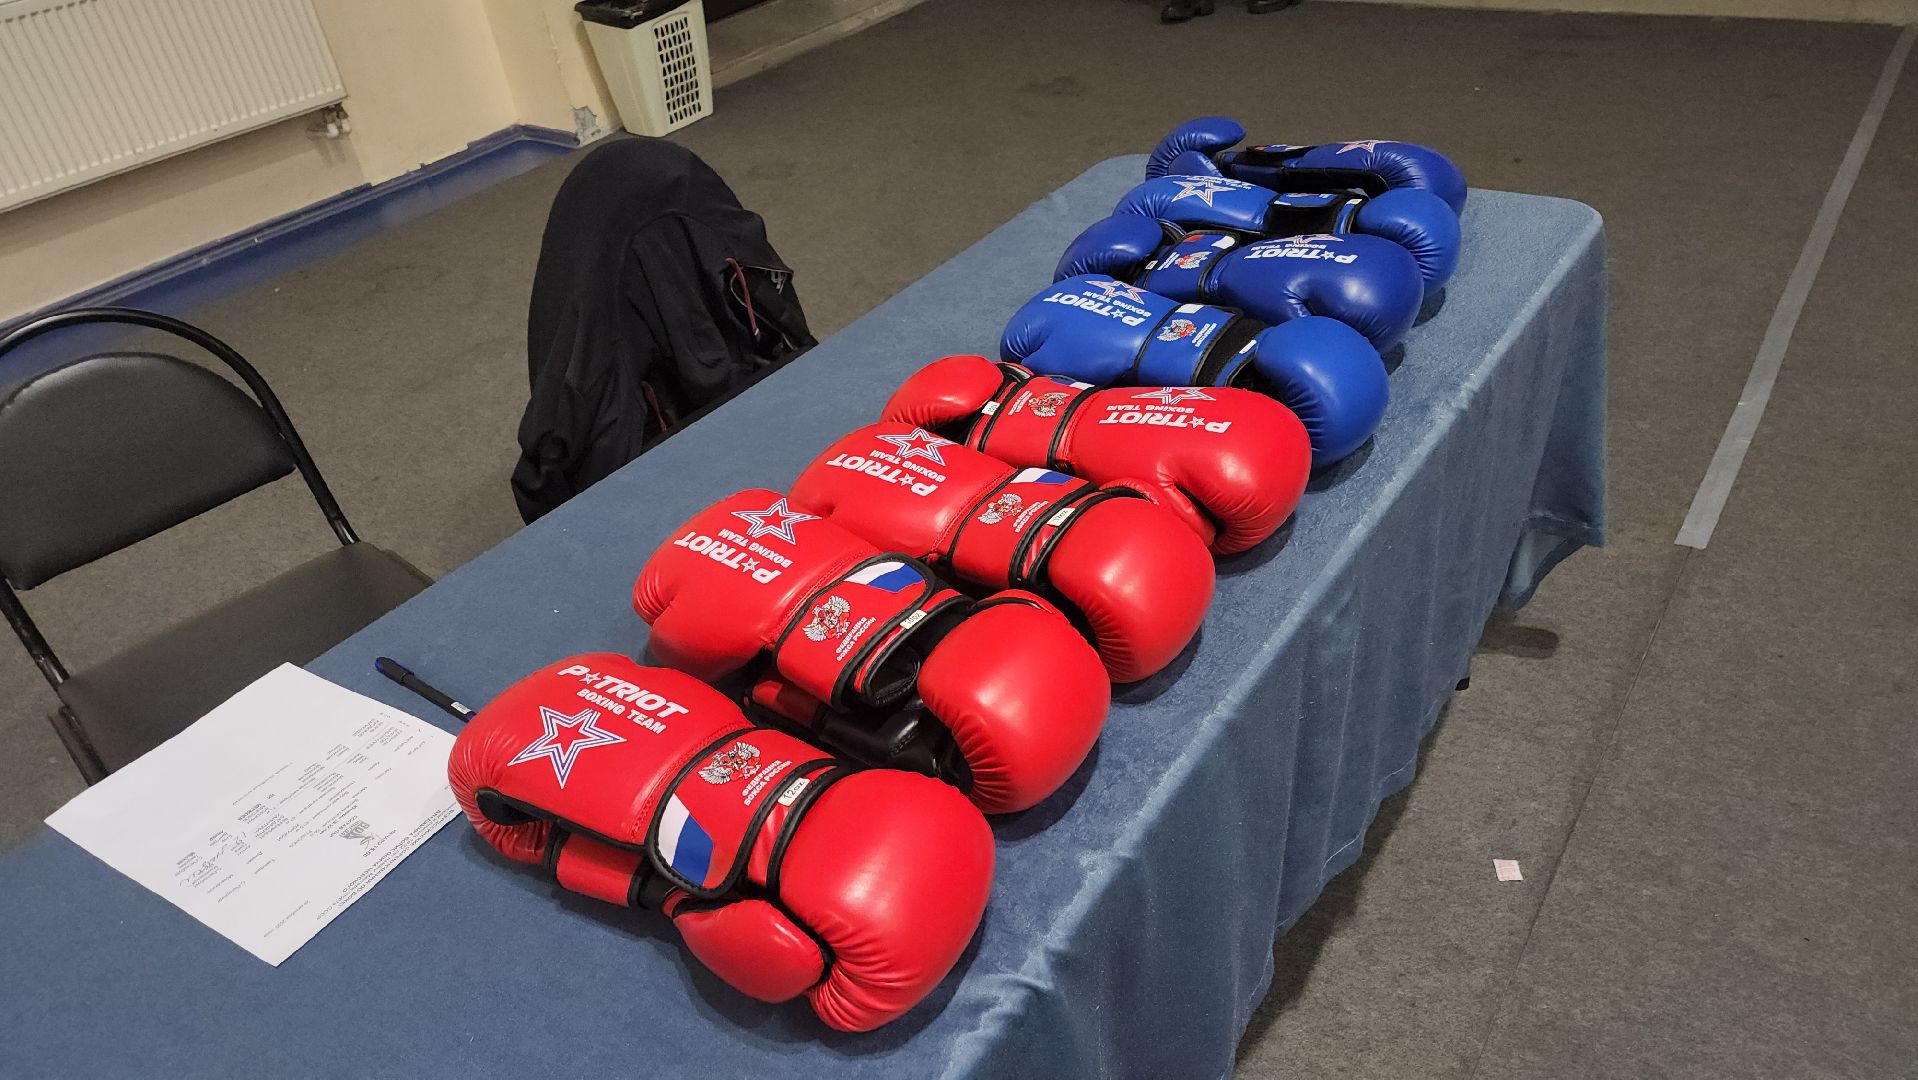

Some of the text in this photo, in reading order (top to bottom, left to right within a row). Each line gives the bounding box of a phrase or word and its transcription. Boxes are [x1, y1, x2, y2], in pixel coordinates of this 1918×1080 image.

[1145, 404, 1195, 414] BOXING
[869, 449, 946, 483] BOXING TEAM
[717, 528, 794, 568] BOXING TEAM
[576, 688, 667, 734] BOXING TEAM
